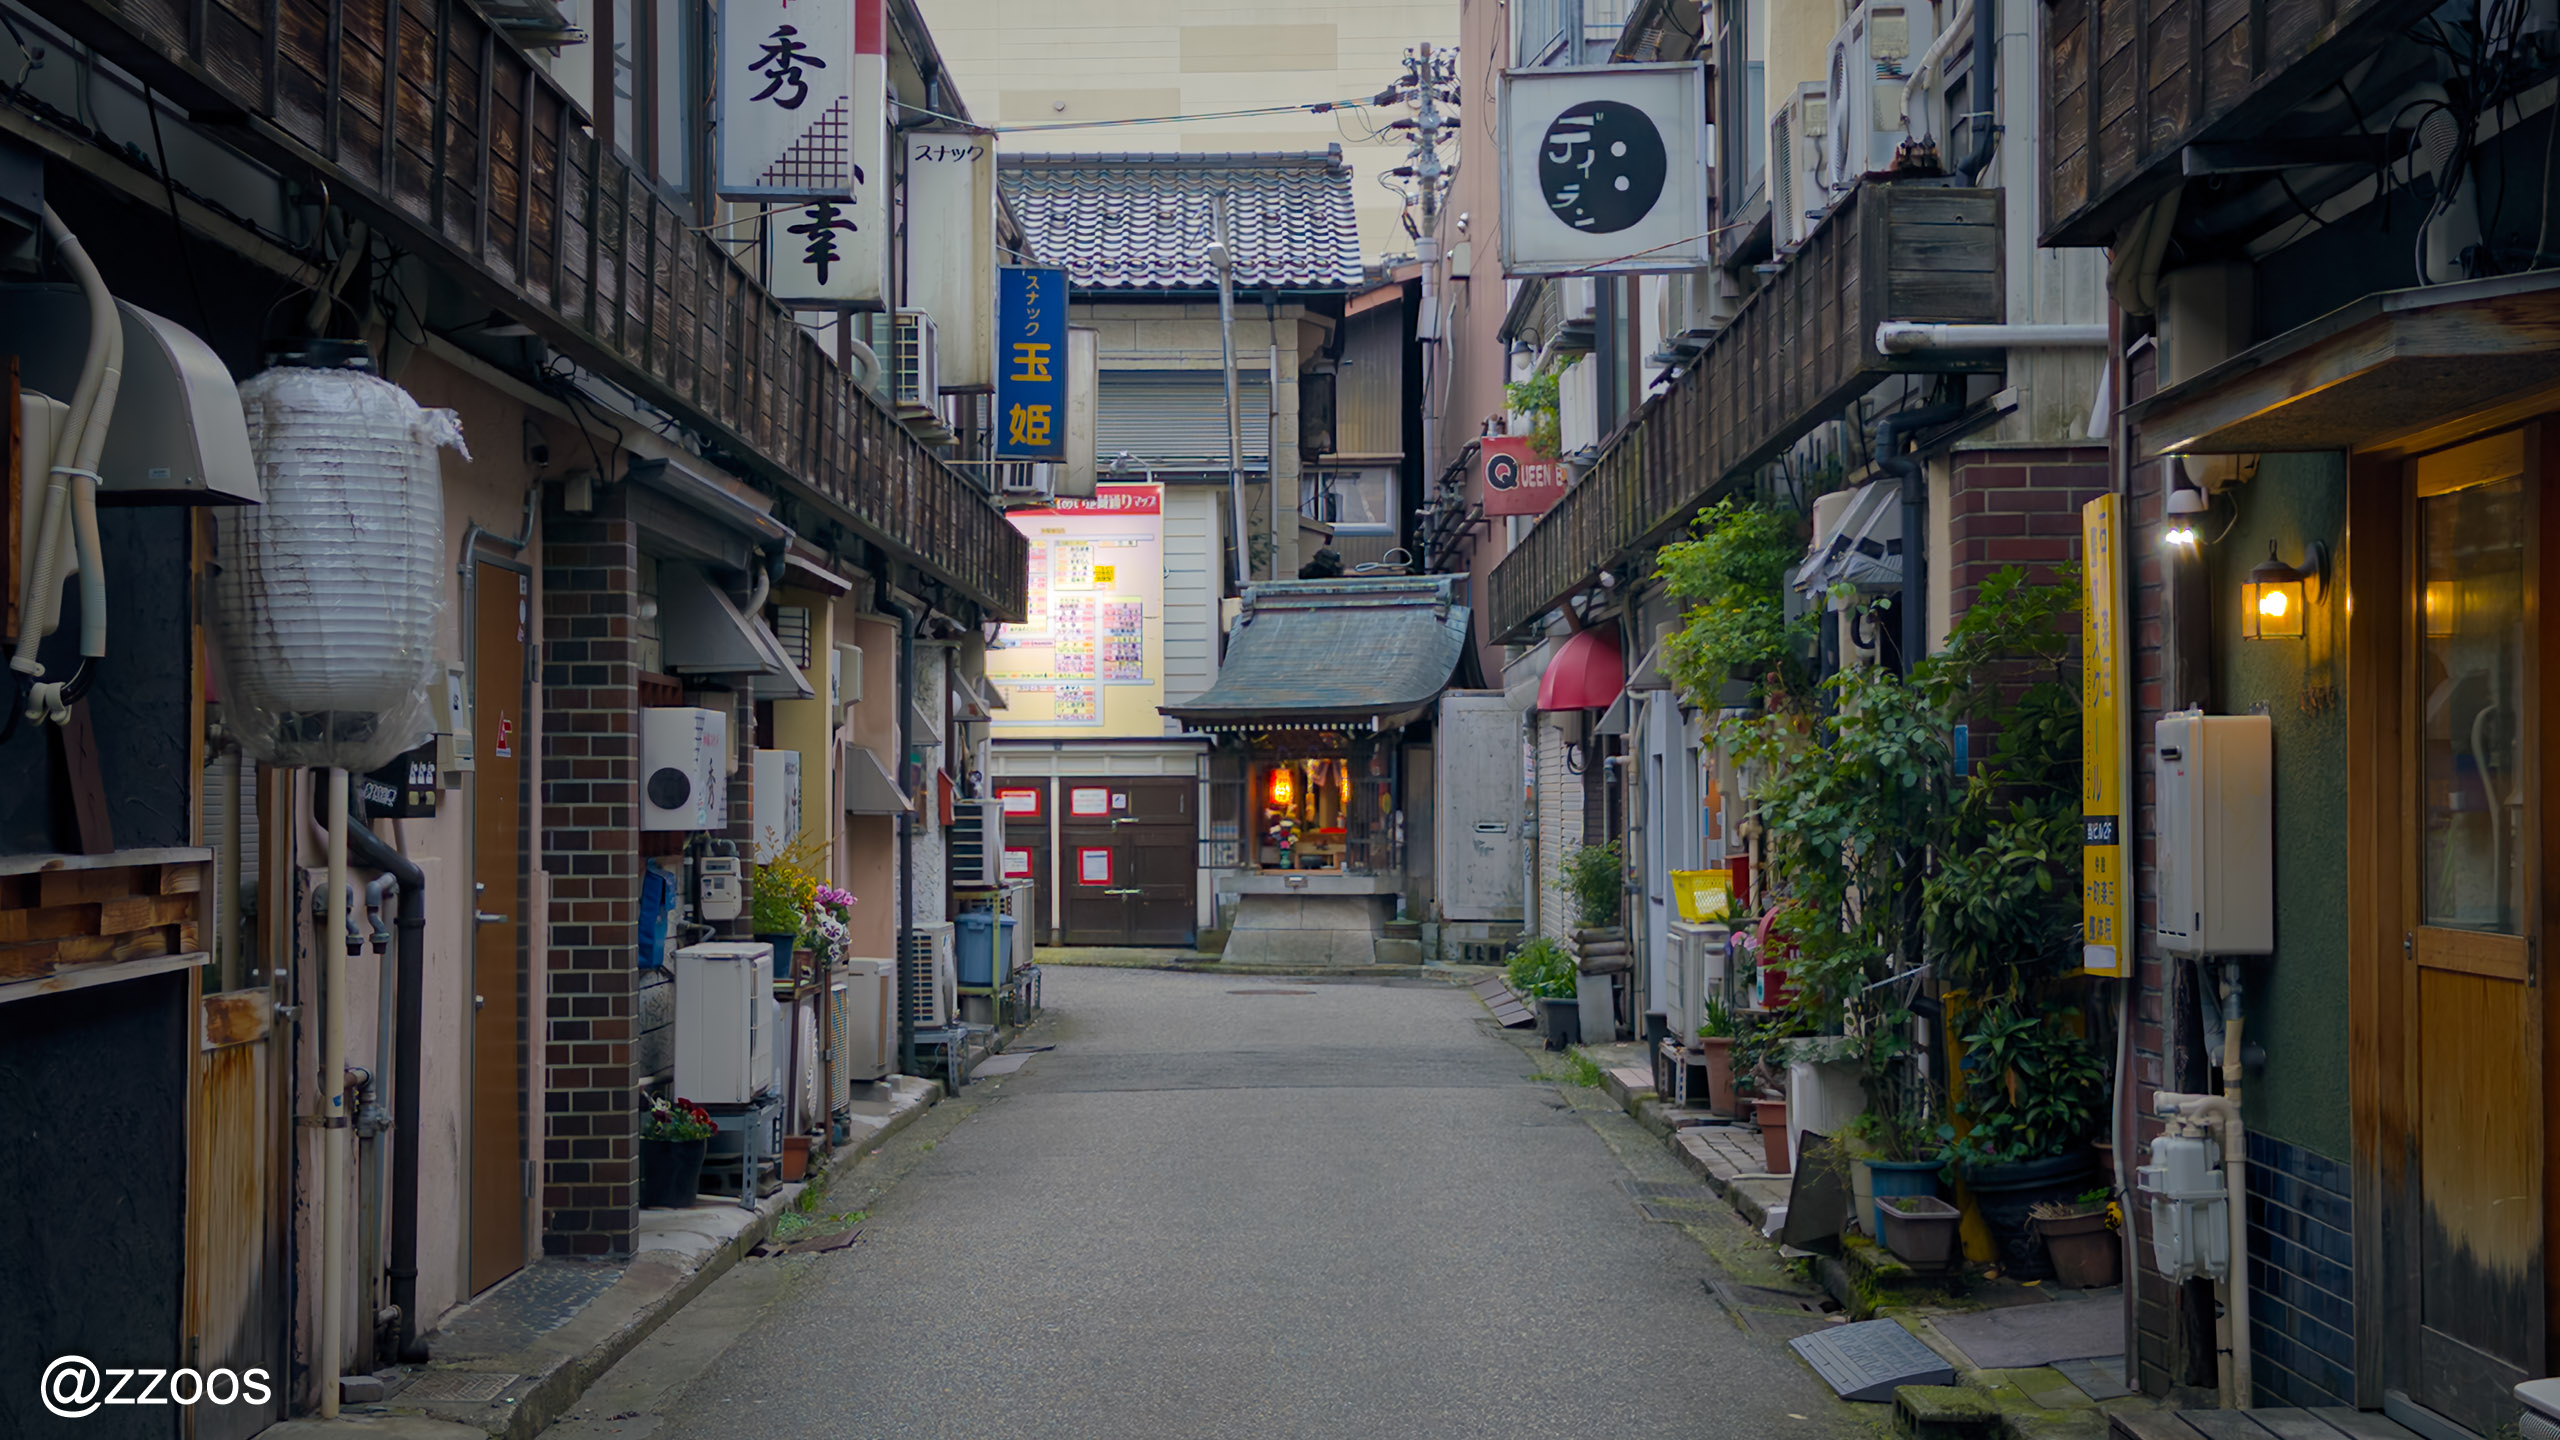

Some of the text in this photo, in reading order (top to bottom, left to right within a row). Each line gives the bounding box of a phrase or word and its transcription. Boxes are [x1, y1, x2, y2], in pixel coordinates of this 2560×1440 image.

[748, 24, 826, 110] 秀
[914, 145, 984, 162] スナック
[1009, 275, 1052, 446] スナック 玉姫
[1485, 452, 1551, 491] QUEEN
